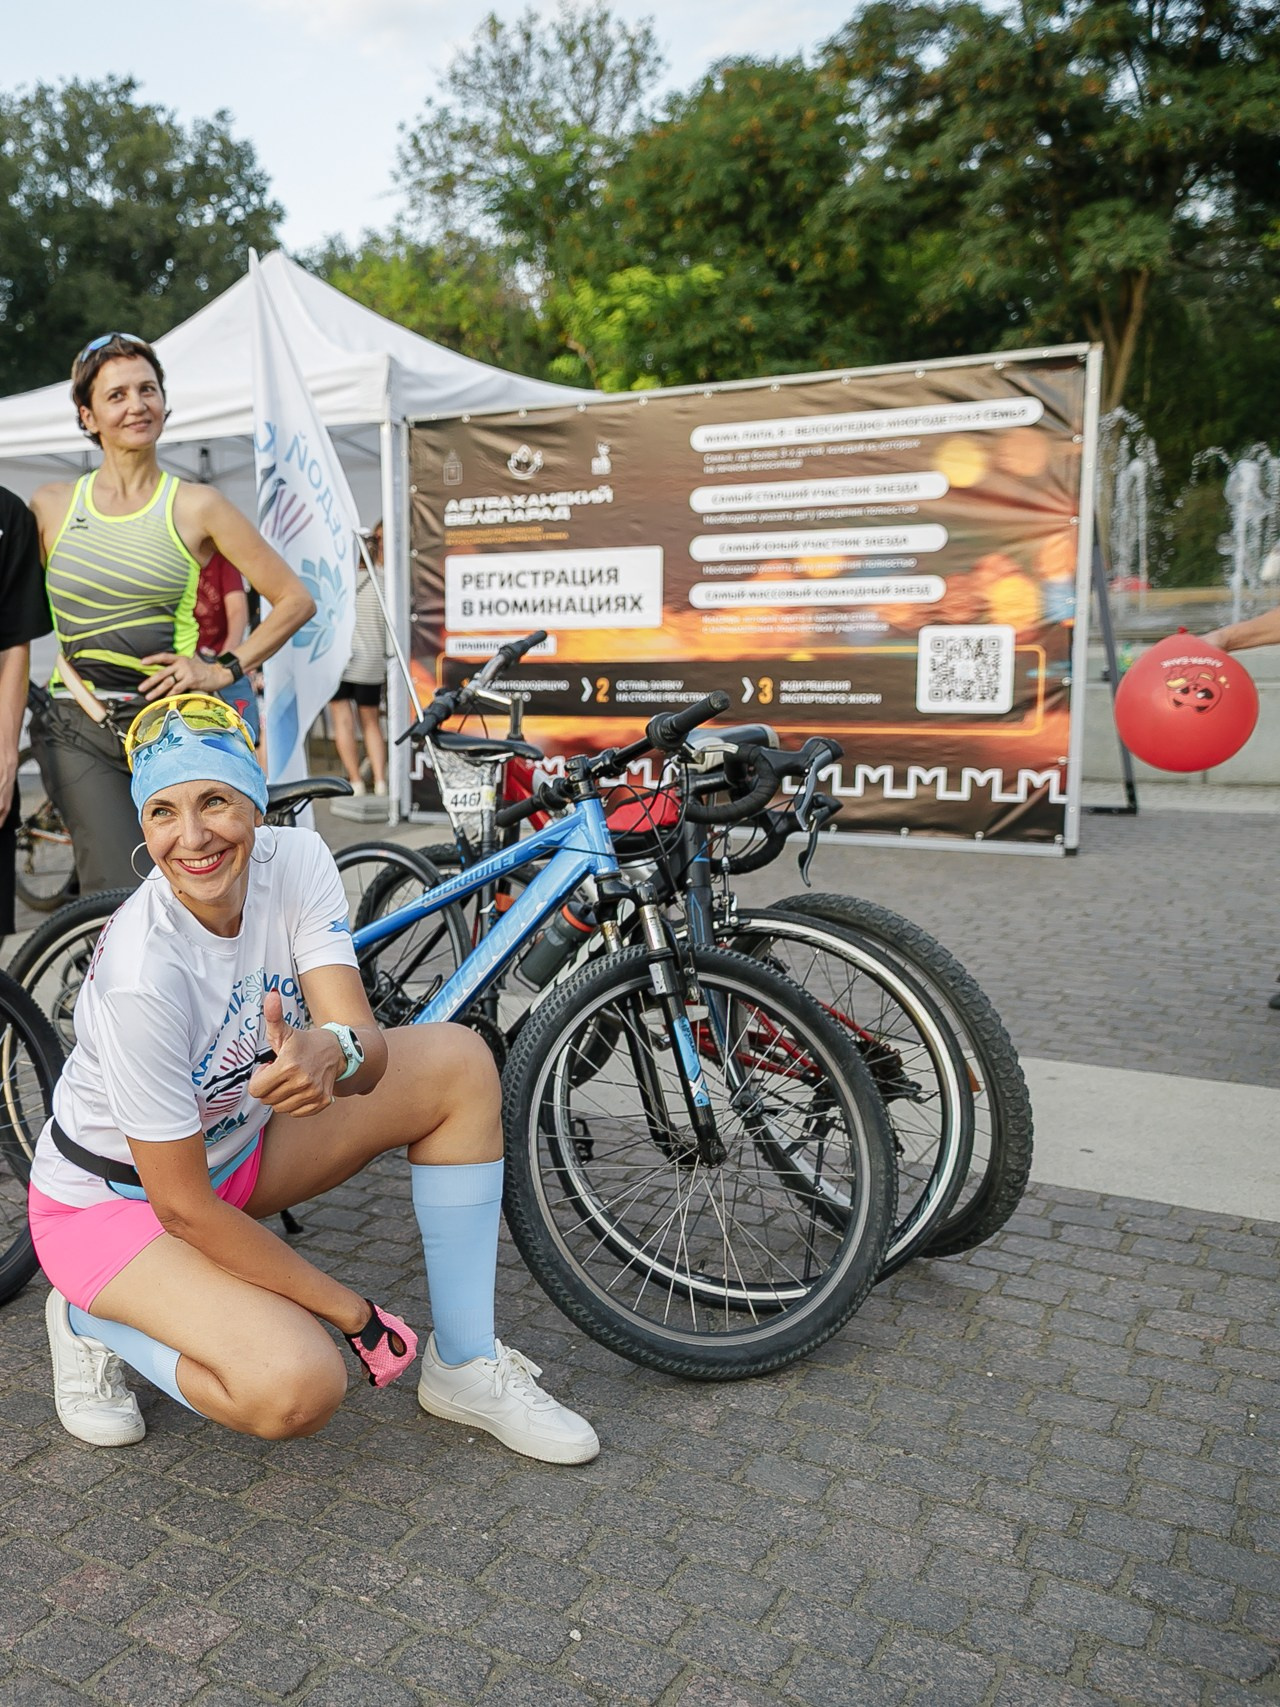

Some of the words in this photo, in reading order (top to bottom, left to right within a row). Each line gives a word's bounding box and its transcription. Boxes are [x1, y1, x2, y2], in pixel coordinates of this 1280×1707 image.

[445, 485, 613, 513] АСТРАХАНСКИЙ
[444, 505, 571, 527] ВЕЛОПАРАД
[461, 565, 619, 591] РЕГИСТРАЦИЯ
[461, 601, 474, 616] В
[479, 594, 644, 617] НОМИНАЦИЯХ
[596, 677, 610, 703] 2
[758, 676, 774, 704] 3
